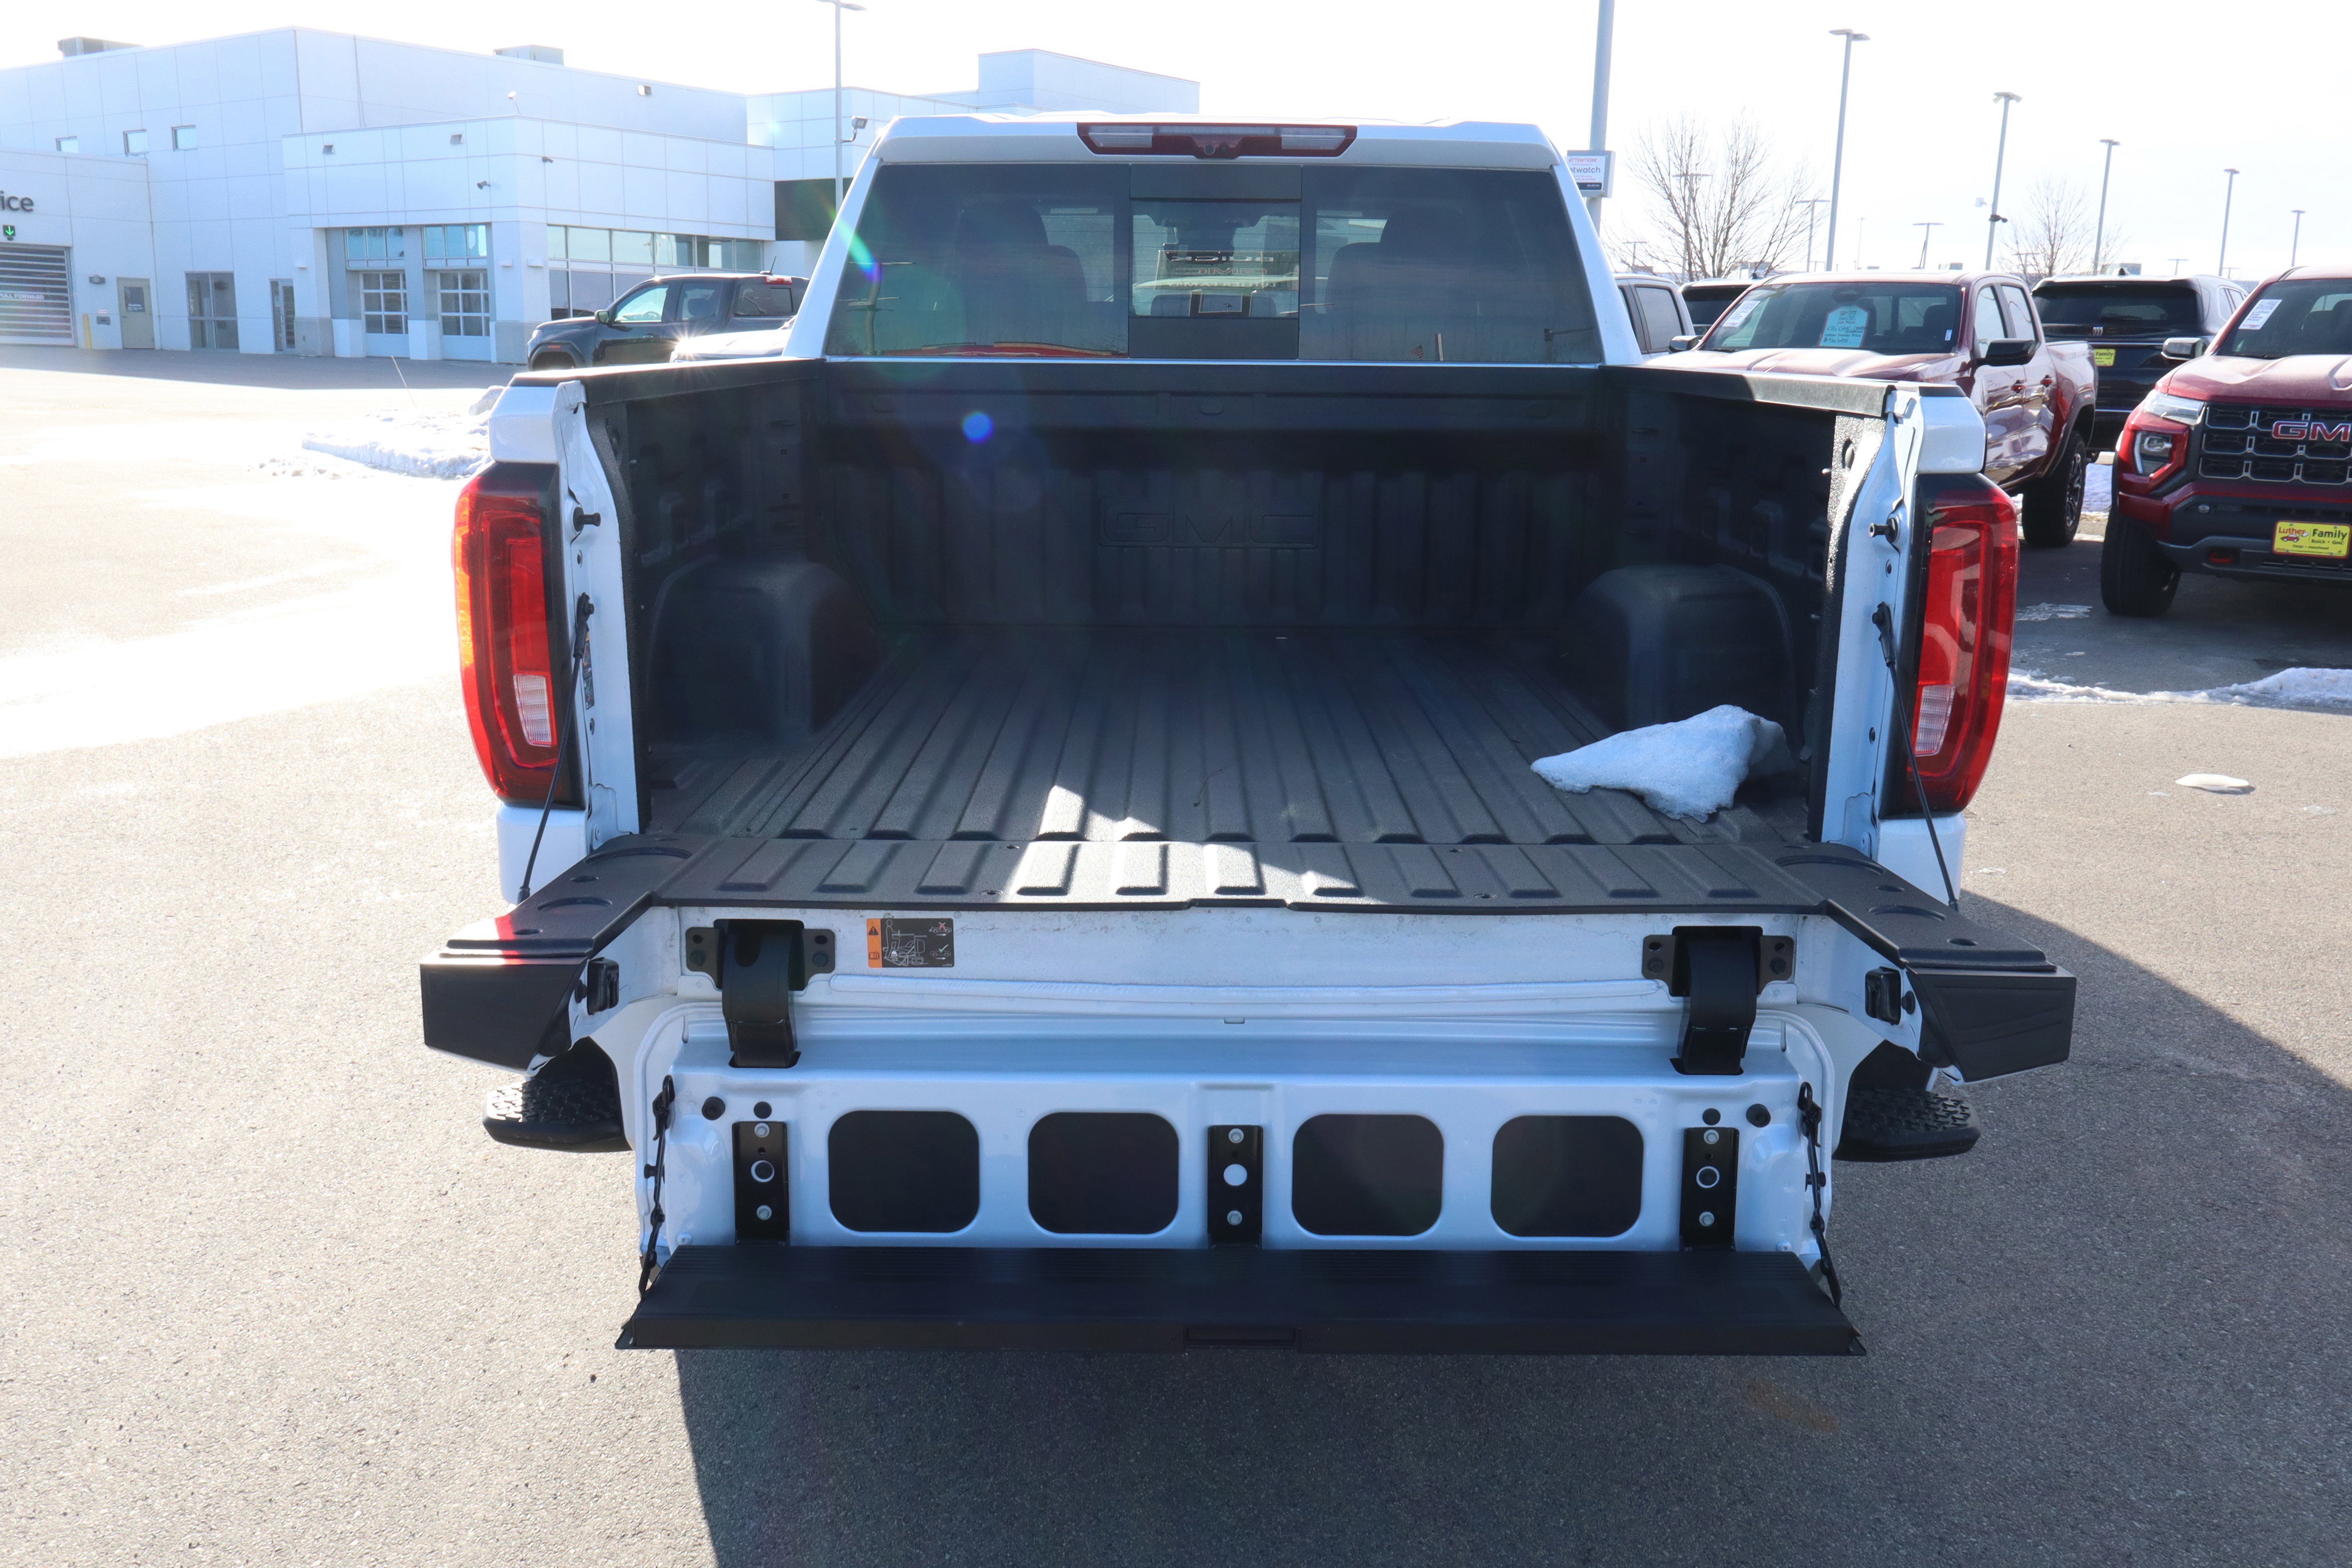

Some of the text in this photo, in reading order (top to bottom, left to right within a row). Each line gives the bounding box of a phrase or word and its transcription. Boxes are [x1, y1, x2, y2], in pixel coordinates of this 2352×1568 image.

[1104, 505, 1316, 543] GMC
[2278, 527, 2306, 535] Luther
[2312, 528, 2348, 541] Family
